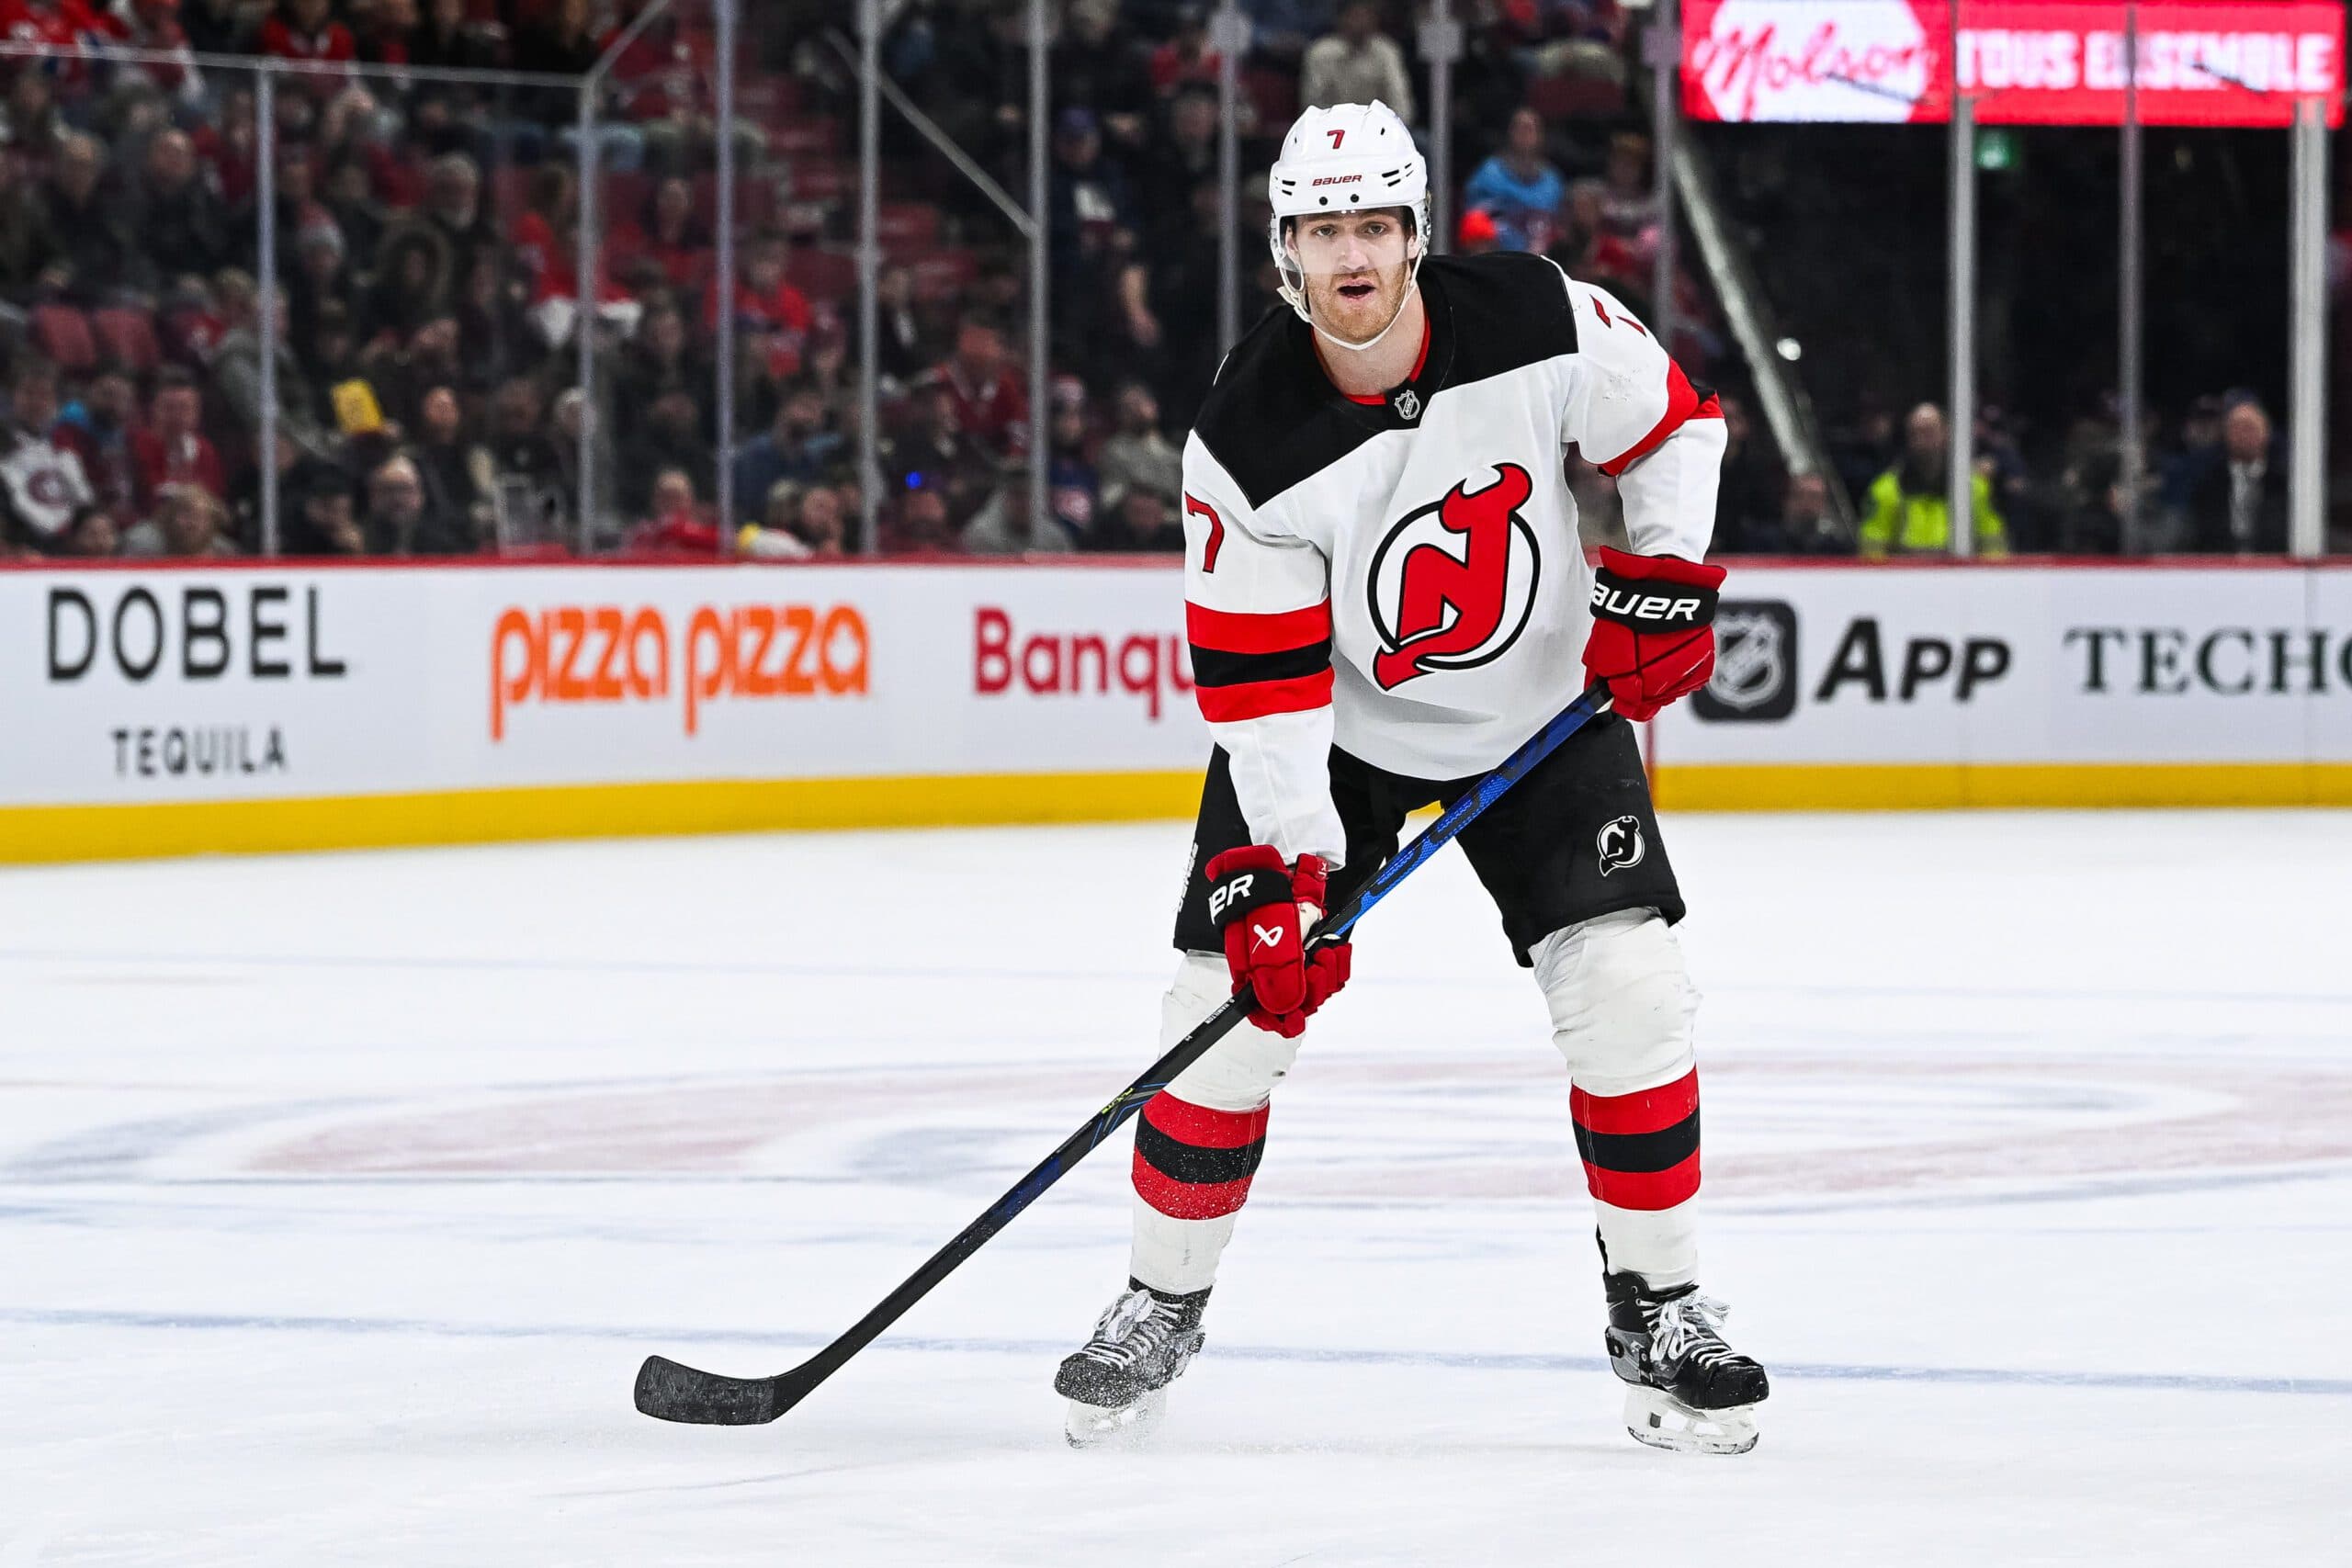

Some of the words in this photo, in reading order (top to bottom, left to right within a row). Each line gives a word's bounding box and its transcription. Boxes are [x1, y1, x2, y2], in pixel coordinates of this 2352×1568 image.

[1956, 29, 2078, 89] TOUS
[1327, 130, 1345, 150] 7
[1184, 490, 1225, 574] 7
[47, 586, 347, 682] DOBEL
[491, 605, 669, 740] pizza
[684, 604, 871, 737] pizza
[974, 607, 1195, 722] Banqu
[110, 723, 287, 776] TEQUILA
